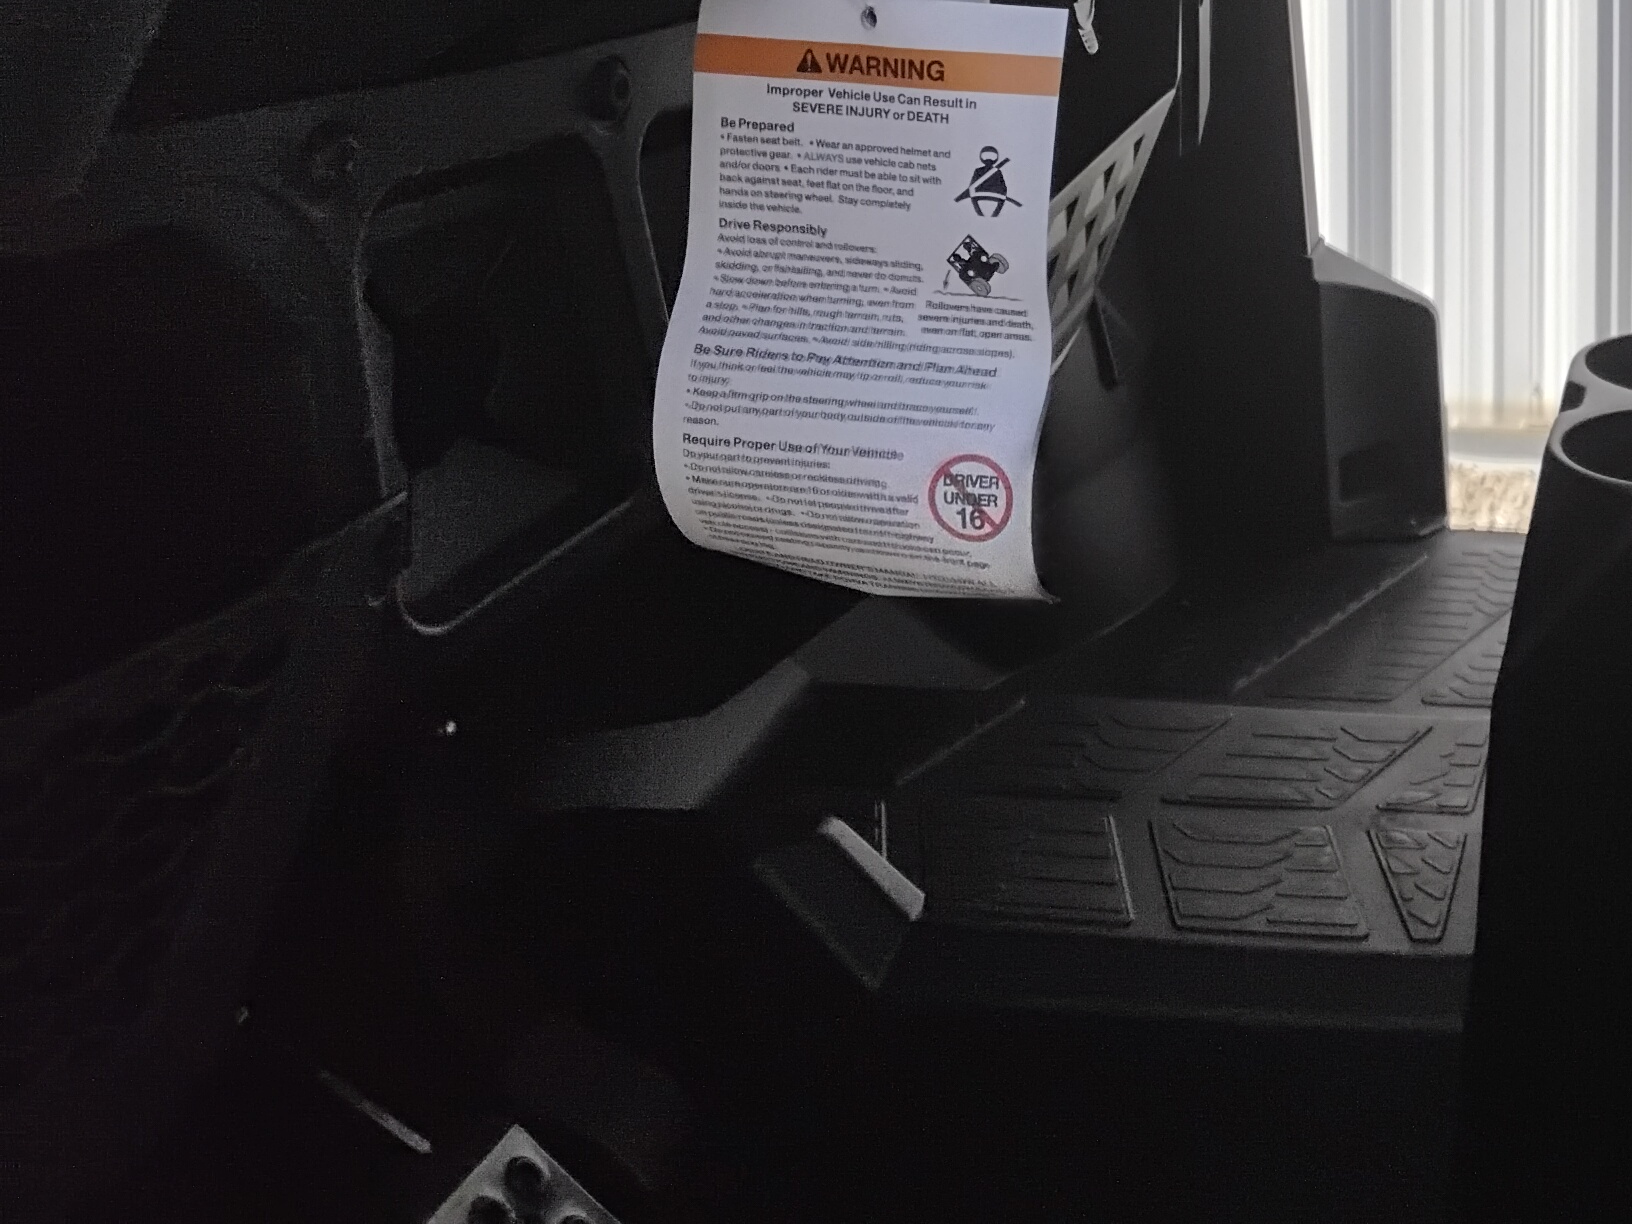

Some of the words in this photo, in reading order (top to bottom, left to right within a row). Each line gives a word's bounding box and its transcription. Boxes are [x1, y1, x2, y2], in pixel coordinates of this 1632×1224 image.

[826, 52, 945, 82] WARNING
[767, 83, 823, 98] Improper
[828, 87, 871, 101] Vehicle
[873, 91, 895, 103] Use
[898, 94, 920, 106] Can
[924, 95, 963, 108] Result
[966, 98, 977, 109] in
[793, 101, 843, 116] SEVERE
[846, 106, 890, 119] INJURY
[893, 111, 904, 120] or
[907, 111, 949, 124] DEATH
[721, 117, 736, 128] Be
[739, 118, 795, 132] Prepared
[727, 133, 758, 144] Fasten
[760, 136, 780, 145] seat
[816, 139, 840, 149] Wear
[842, 142, 853, 150] an
[855, 143, 898, 154] approved
[900, 146, 931, 157] helmet
[933, 150, 951, 158] and
[720, 147, 767, 157] protective
[804, 151, 843, 163] ALWAYS
[864, 157, 896, 167] vehicle
[898, 160, 914, 169] cab
[917, 163, 936, 171] nets
[720, 160, 750, 169] and/or
[791, 164, 814, 174] Each
[816, 166, 838, 176] rider
[840, 169, 862, 178] must
[864, 170, 876, 179] be
[878, 172, 896, 181] able
[899, 174, 908, 182] to
[910, 175, 920, 183] sit
[922, 176, 942, 185] with
[720, 173, 742, 182] back
[744, 176, 780, 186] against
[806, 179, 824, 188] feet
[826, 180, 840, 190] flat
[842, 183, 854, 191] on
[856, 183, 870, 192] the
[896, 188, 914, 196] and
[719, 200, 748, 210] inside
[750, 202, 765, 210] the
[720, 187, 748, 196] hands
[764, 190, 802, 202] steering
[839, 195, 858, 206] Stay
[860, 198, 911, 211] completely
[719, 218, 750, 229] Drive
[754, 220, 828, 238] Responsibly
[694, 343, 710, 355] Be
[714, 345, 744, 357] Sure
[746, 347, 788, 360] Riders
[790, 352, 804, 362] to
[806, 352, 831, 366] Pay
[832, 355, 895, 370] Attention
[896, 361, 922, 371] and
[924, 362, 954, 374] Plan
[956, 365, 998, 378] Ahead
[683, 433, 730, 447] Require
[734, 437, 776, 451] Proper
[779, 440, 802, 453] Use
[805, 443, 817, 454] of
[820, 444, 849, 457] Your
[852, 446, 904, 461] Vehicle
[943, 473, 999, 489] DRIVER
[944, 492, 998, 507] UNDER
[956, 507, 985, 530] 16
